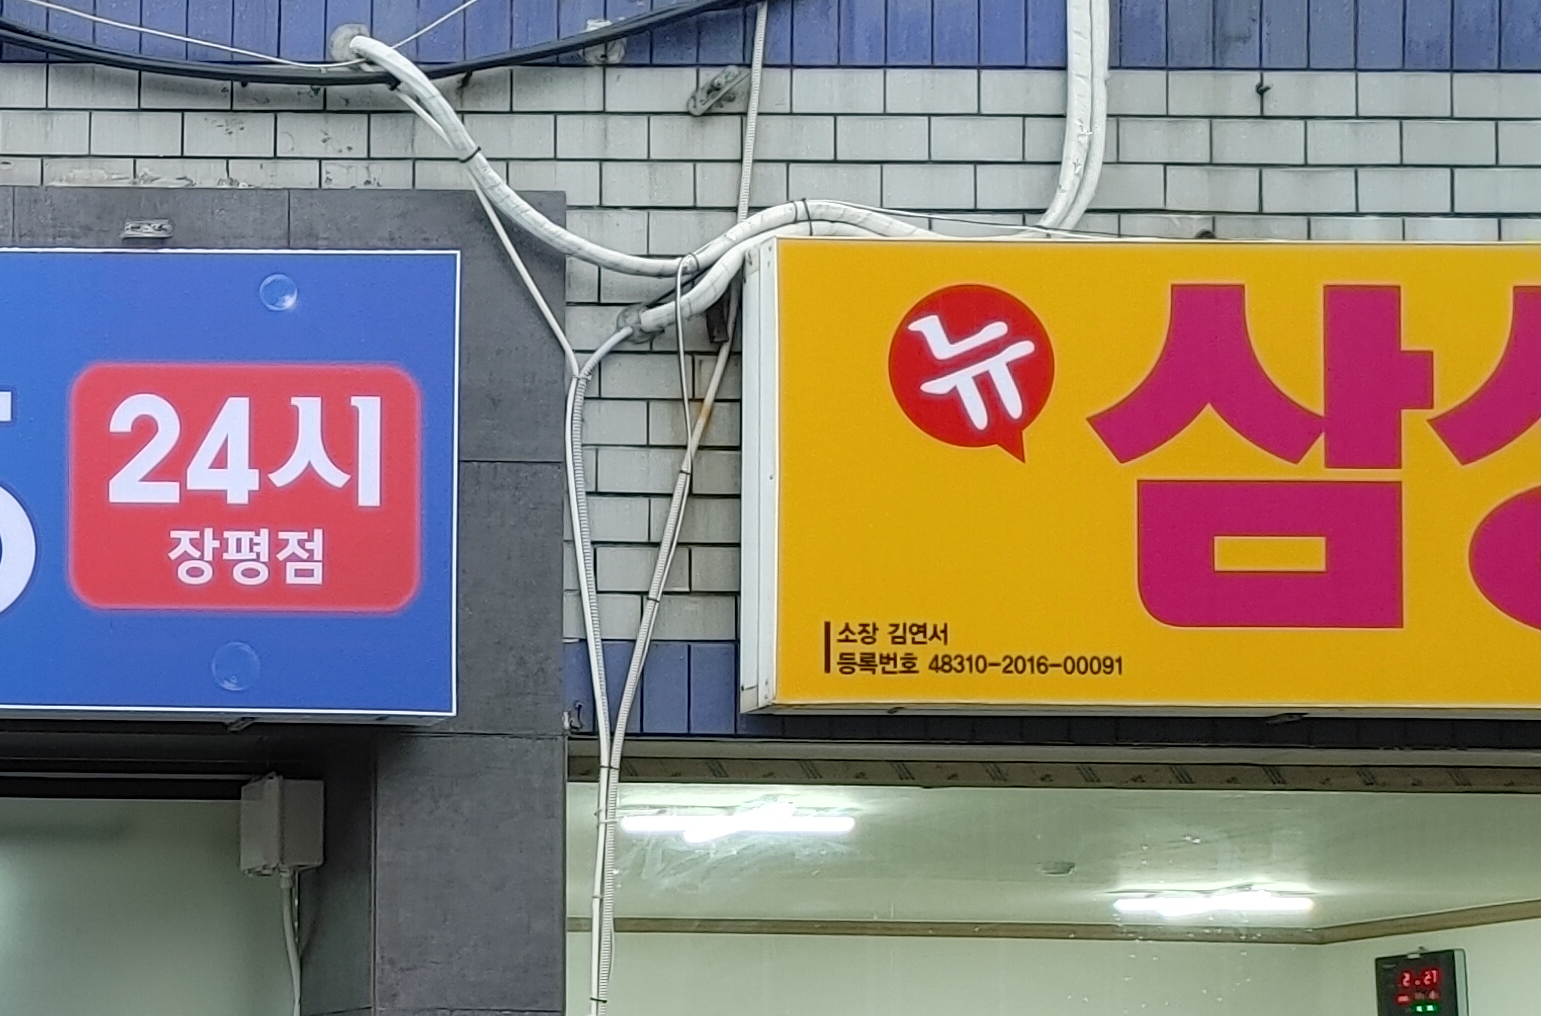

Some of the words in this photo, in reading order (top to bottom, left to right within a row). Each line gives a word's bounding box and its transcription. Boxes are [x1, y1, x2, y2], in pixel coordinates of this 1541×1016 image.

[905, 312, 1036, 432] 뉴
[105, 391, 384, 510] 24시
[166, 524, 326, 588] 장평점
[836, 622, 879, 646] 소장
[886, 621, 950, 647] 김연서
[836, 651, 920, 677] 등록번호
[927, 653, 1125, 677] 48310-2016-00091
